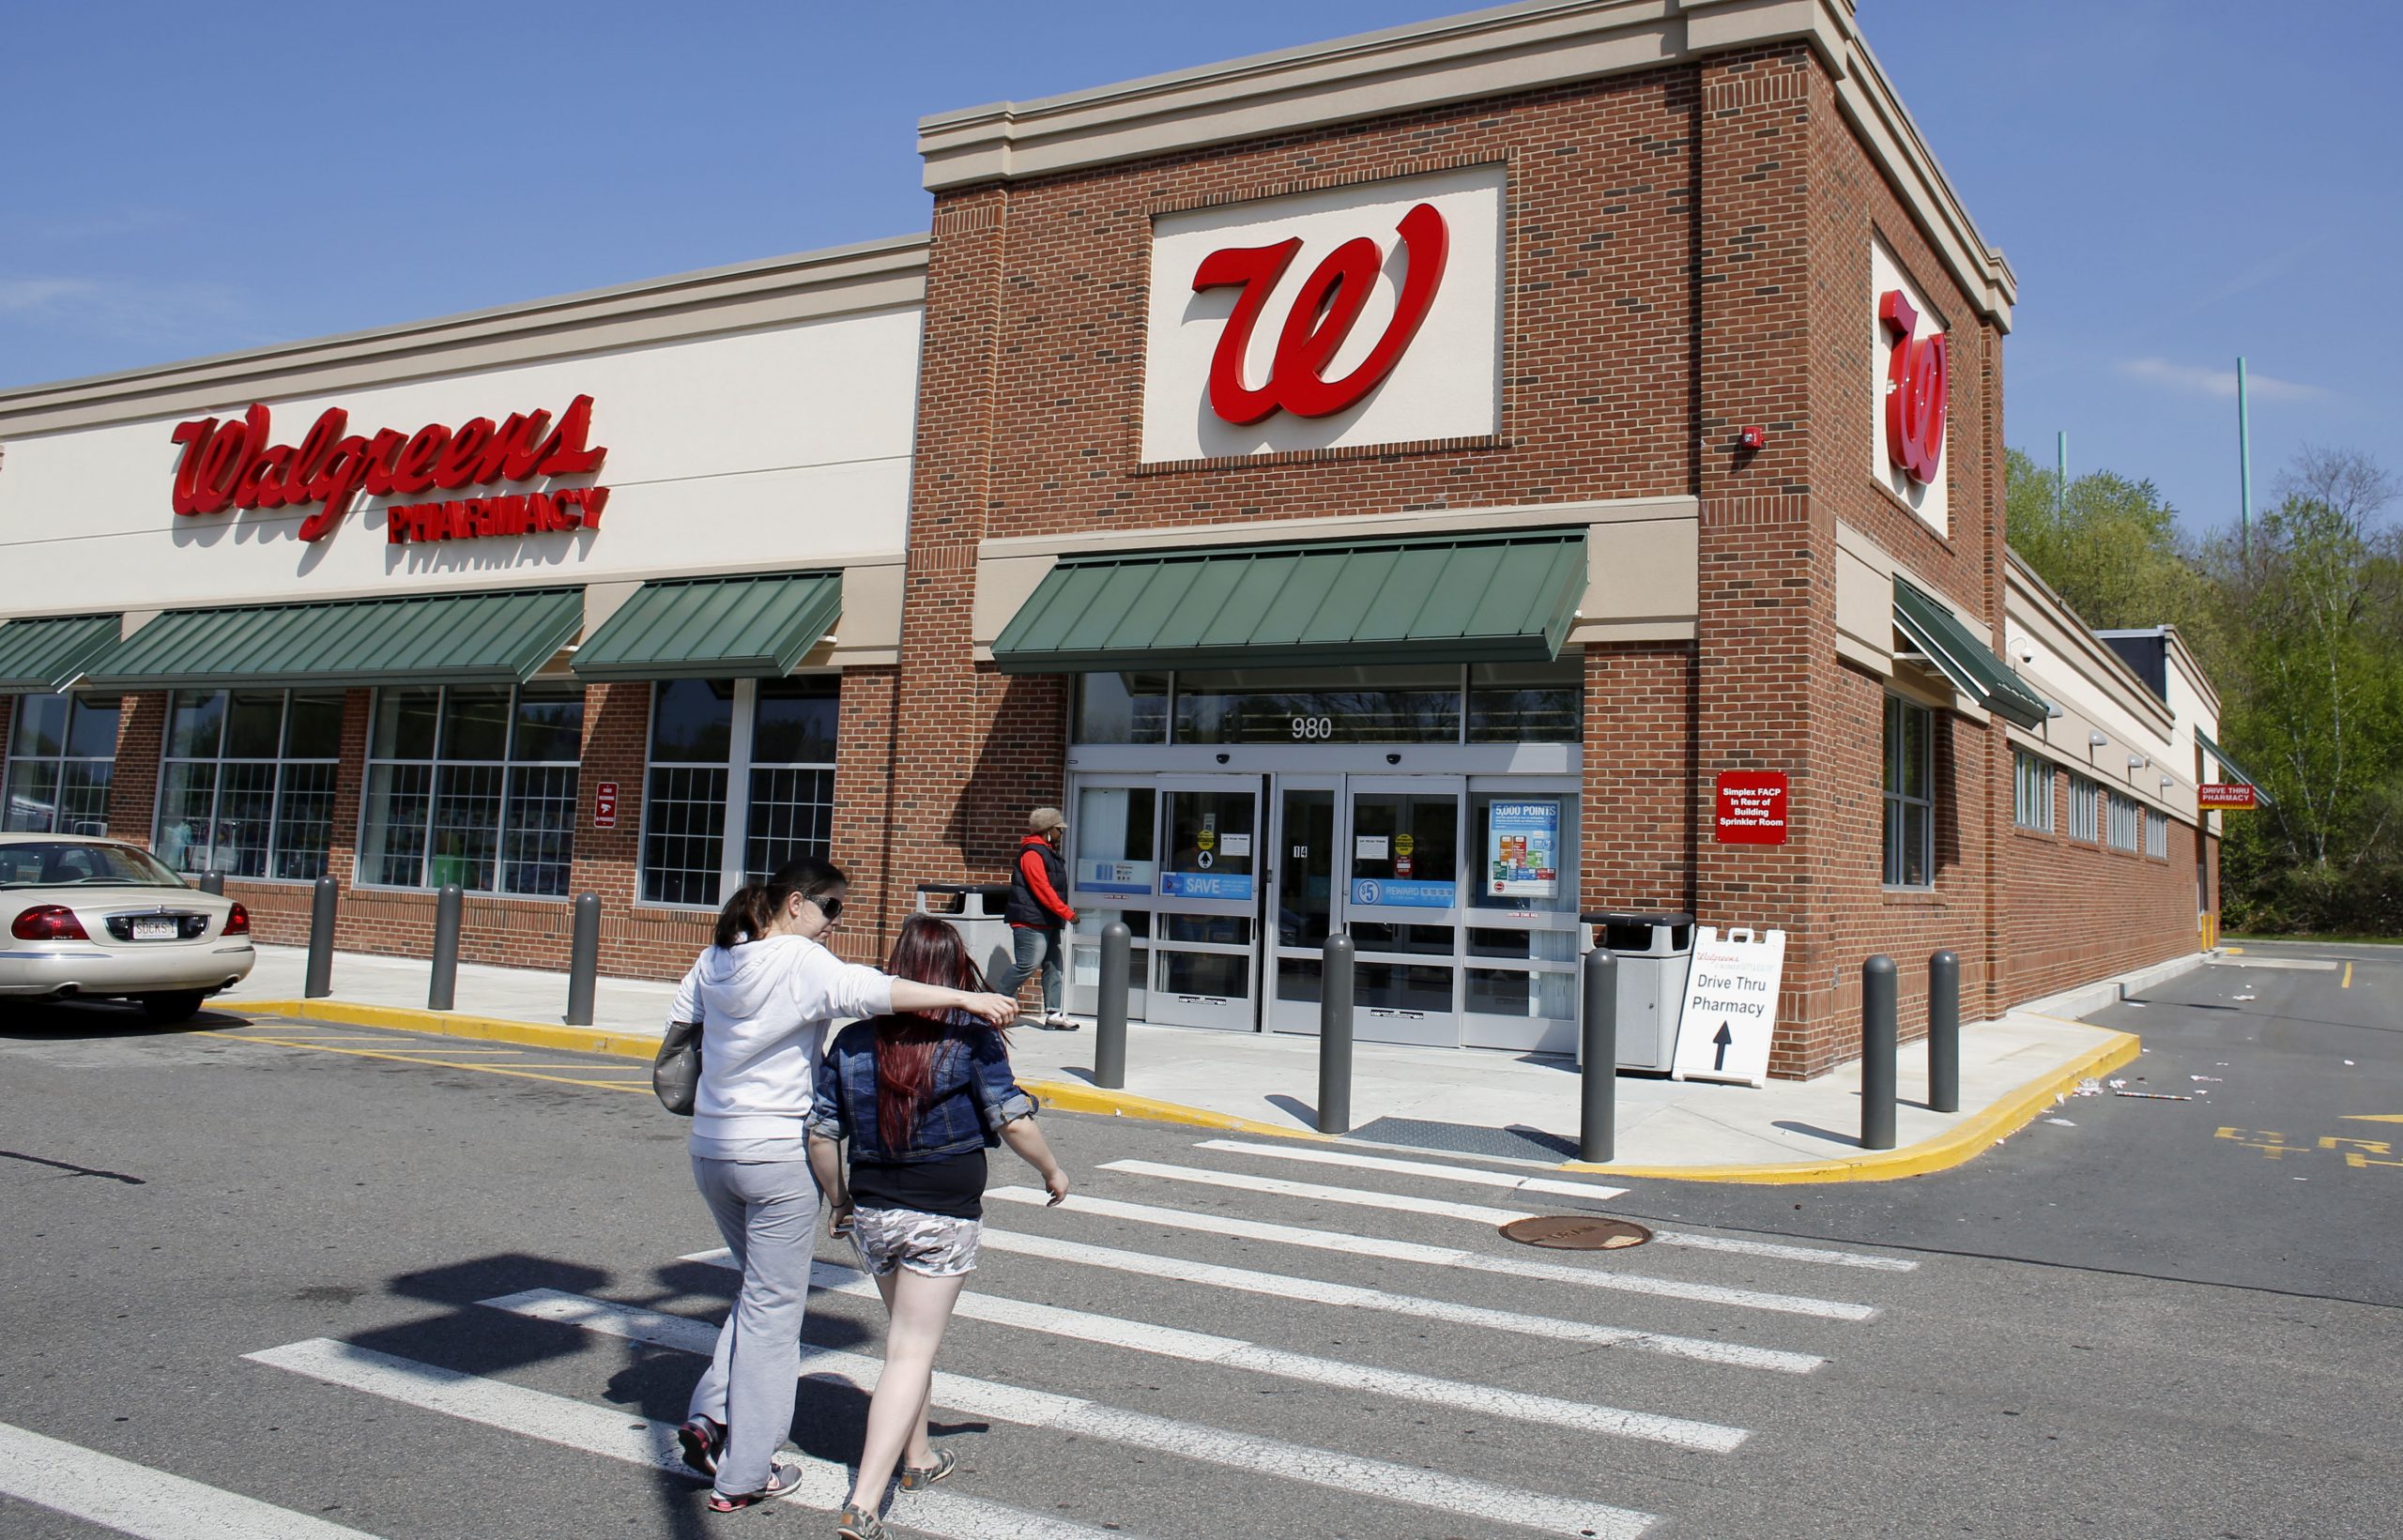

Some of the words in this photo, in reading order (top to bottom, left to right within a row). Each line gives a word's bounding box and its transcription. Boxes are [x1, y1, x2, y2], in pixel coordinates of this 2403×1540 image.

[171, 393, 608, 542] Walgreens
[387, 487, 610, 544] PHARMACY
[1292, 717, 1332, 739] 980
[1722, 787, 1756, 798] Simplex
[1757, 787, 1782, 797] FACP
[1495, 805, 1521, 816] 5,000
[1523, 805, 1556, 816] POINTS
[1730, 798, 1739, 806] In
[1740, 798, 1760, 806] Rear
[1761, 798, 1771, 806] of
[1734, 807, 1769, 817] Building
[1720, 817, 1758, 827] Sprinkler
[1758, 817, 1784, 827] Room
[1186, 877, 1221, 894] SAVE
[1361, 884, 1374, 902] $5
[1385, 886, 1419, 896] REWARD
[1697, 974, 1732, 989] Drive
[1737, 976, 1767, 991] Thru
[1692, 996, 1765, 1018] Pharmacy
